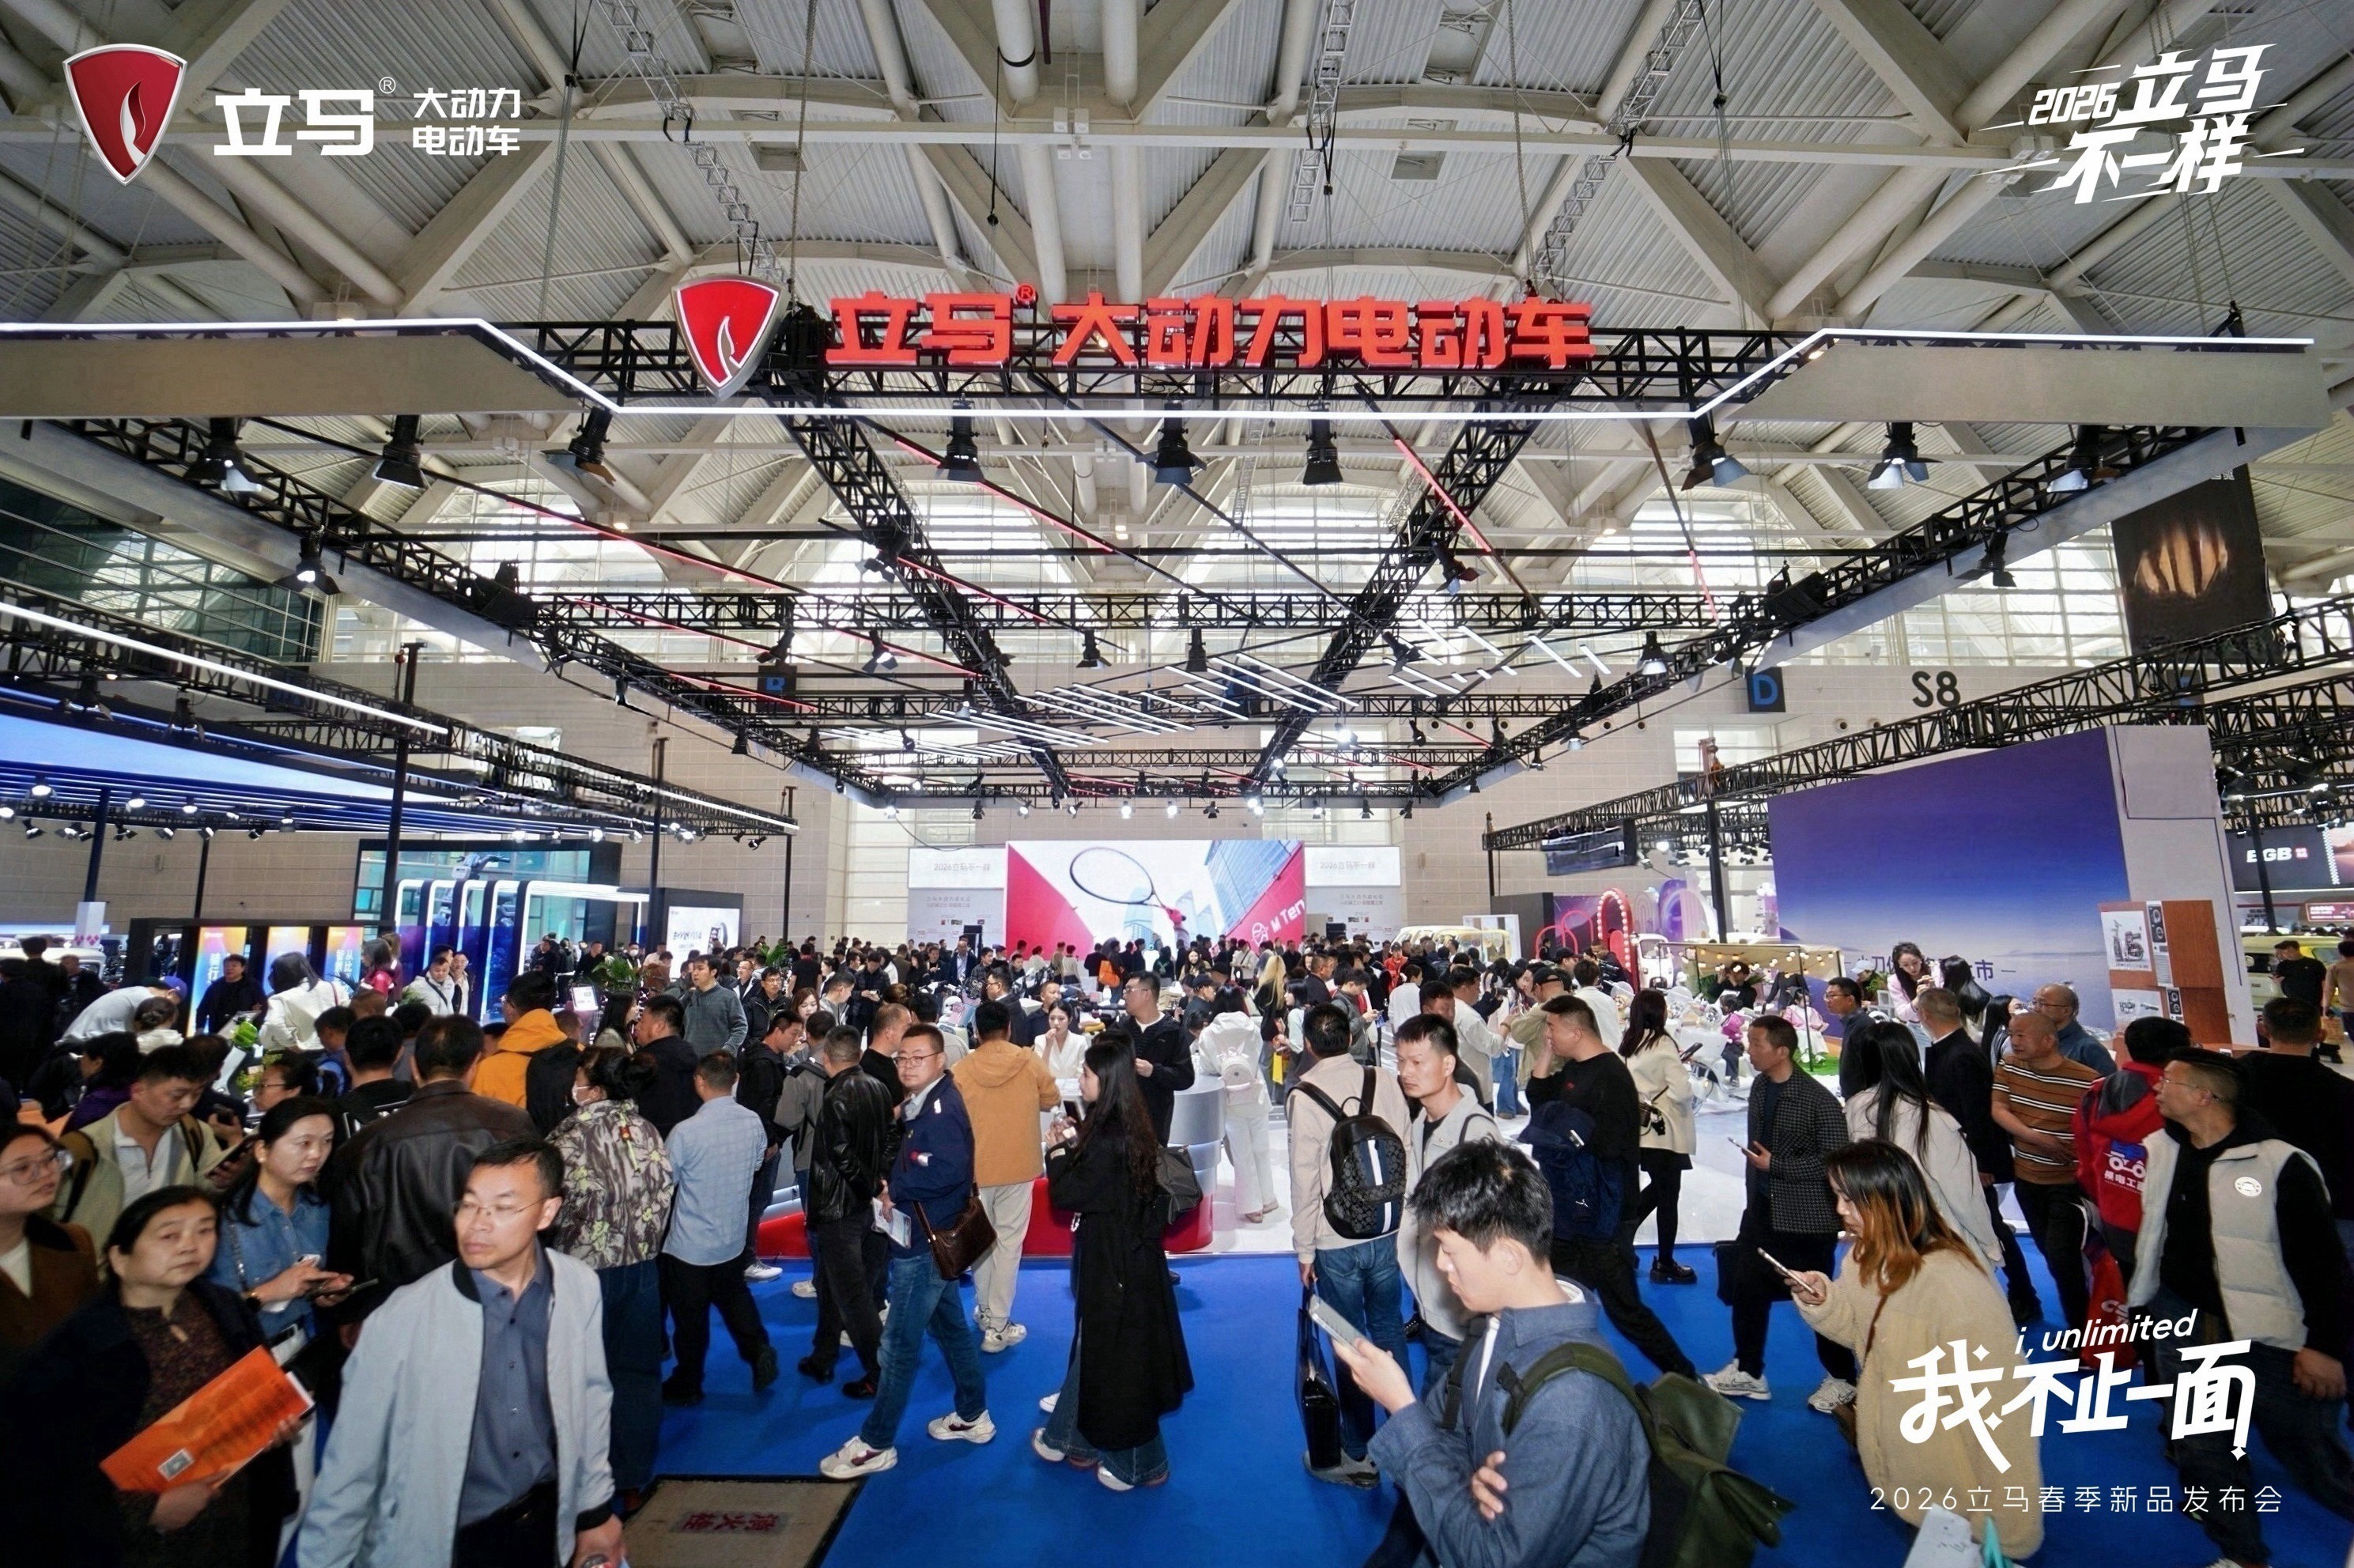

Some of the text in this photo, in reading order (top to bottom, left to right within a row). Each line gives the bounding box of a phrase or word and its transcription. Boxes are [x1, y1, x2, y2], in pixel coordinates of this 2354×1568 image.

[1051, 291, 1596, 368] 大动力电动车
[1752, 674, 1778, 705] D
[1912, 671, 1961, 708] S8
